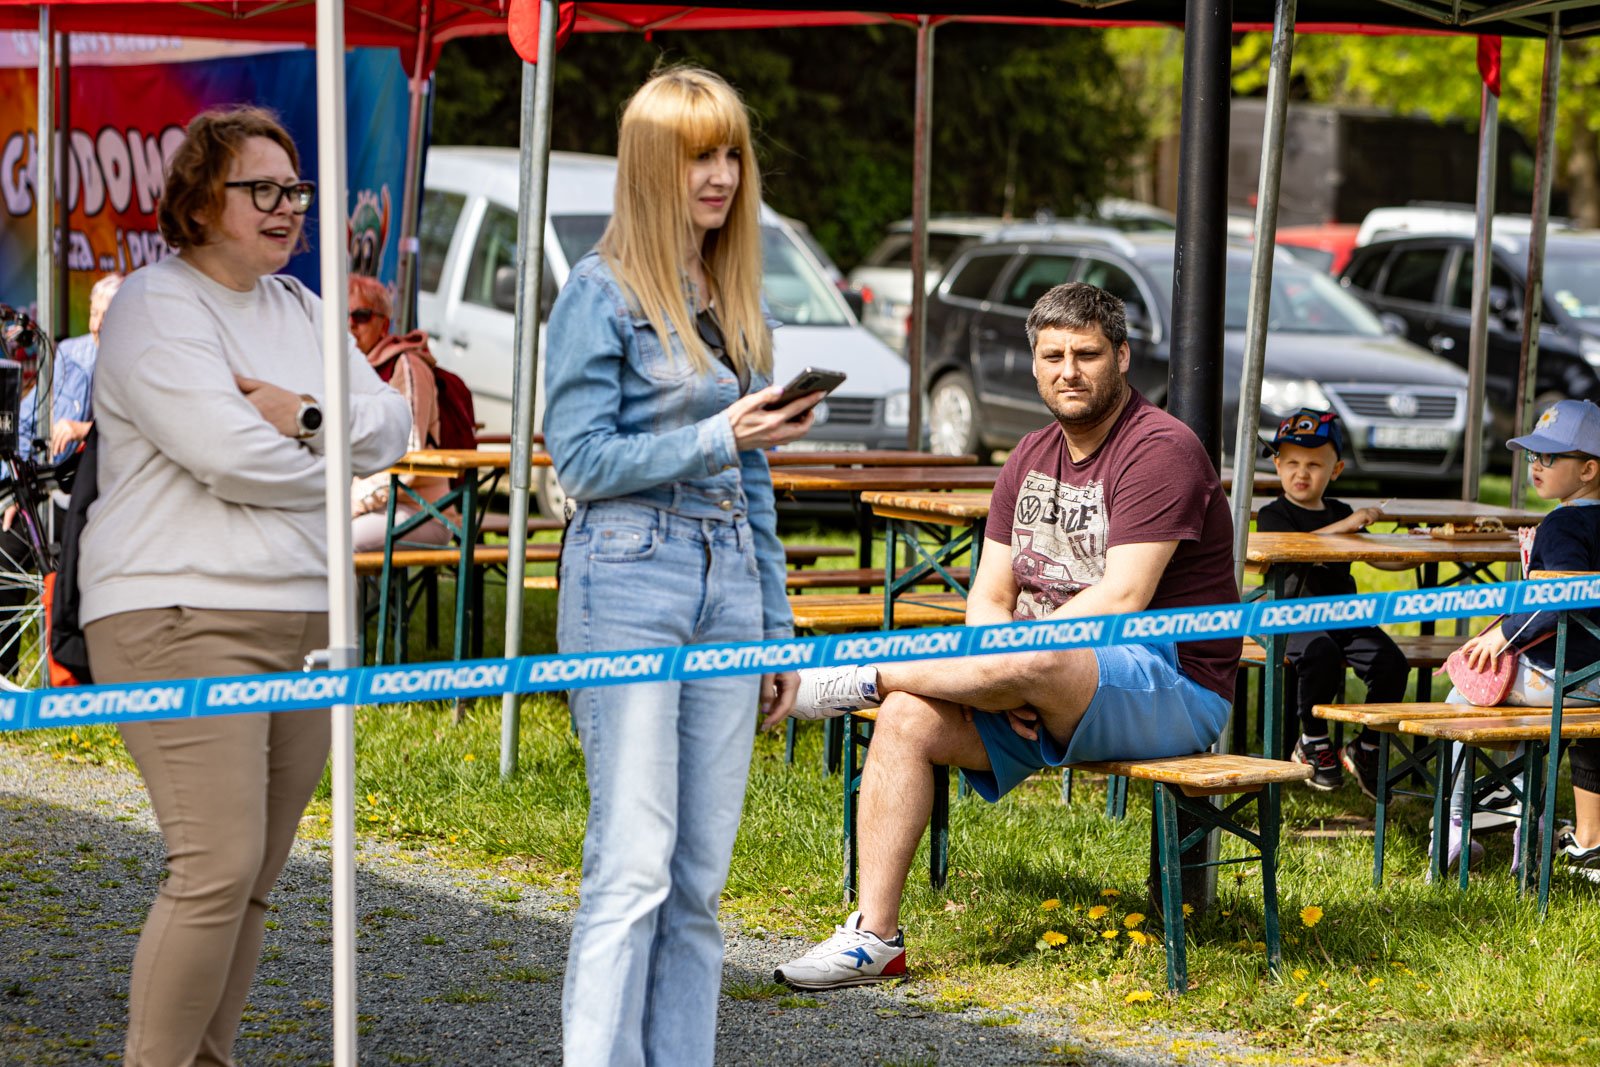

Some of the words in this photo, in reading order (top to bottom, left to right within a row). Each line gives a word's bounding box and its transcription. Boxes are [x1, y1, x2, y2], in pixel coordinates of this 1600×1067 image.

[39, 688, 184, 718] DECATHLON
[206, 677, 349, 705] DECATHLON
[370, 666, 508, 694] DECATHLON
[529, 655, 664, 682] DECATHLON
[683, 644, 815, 671] DECATHLON
[834, 632, 962, 659] DECATHLON
[980, 622, 1104, 648] DECATHLON
[1122, 611, 1243, 637] DECATHLON
[1260, 600, 1377, 626] DECATHLON
[1393, 588, 1507, 615] DECATHLON
